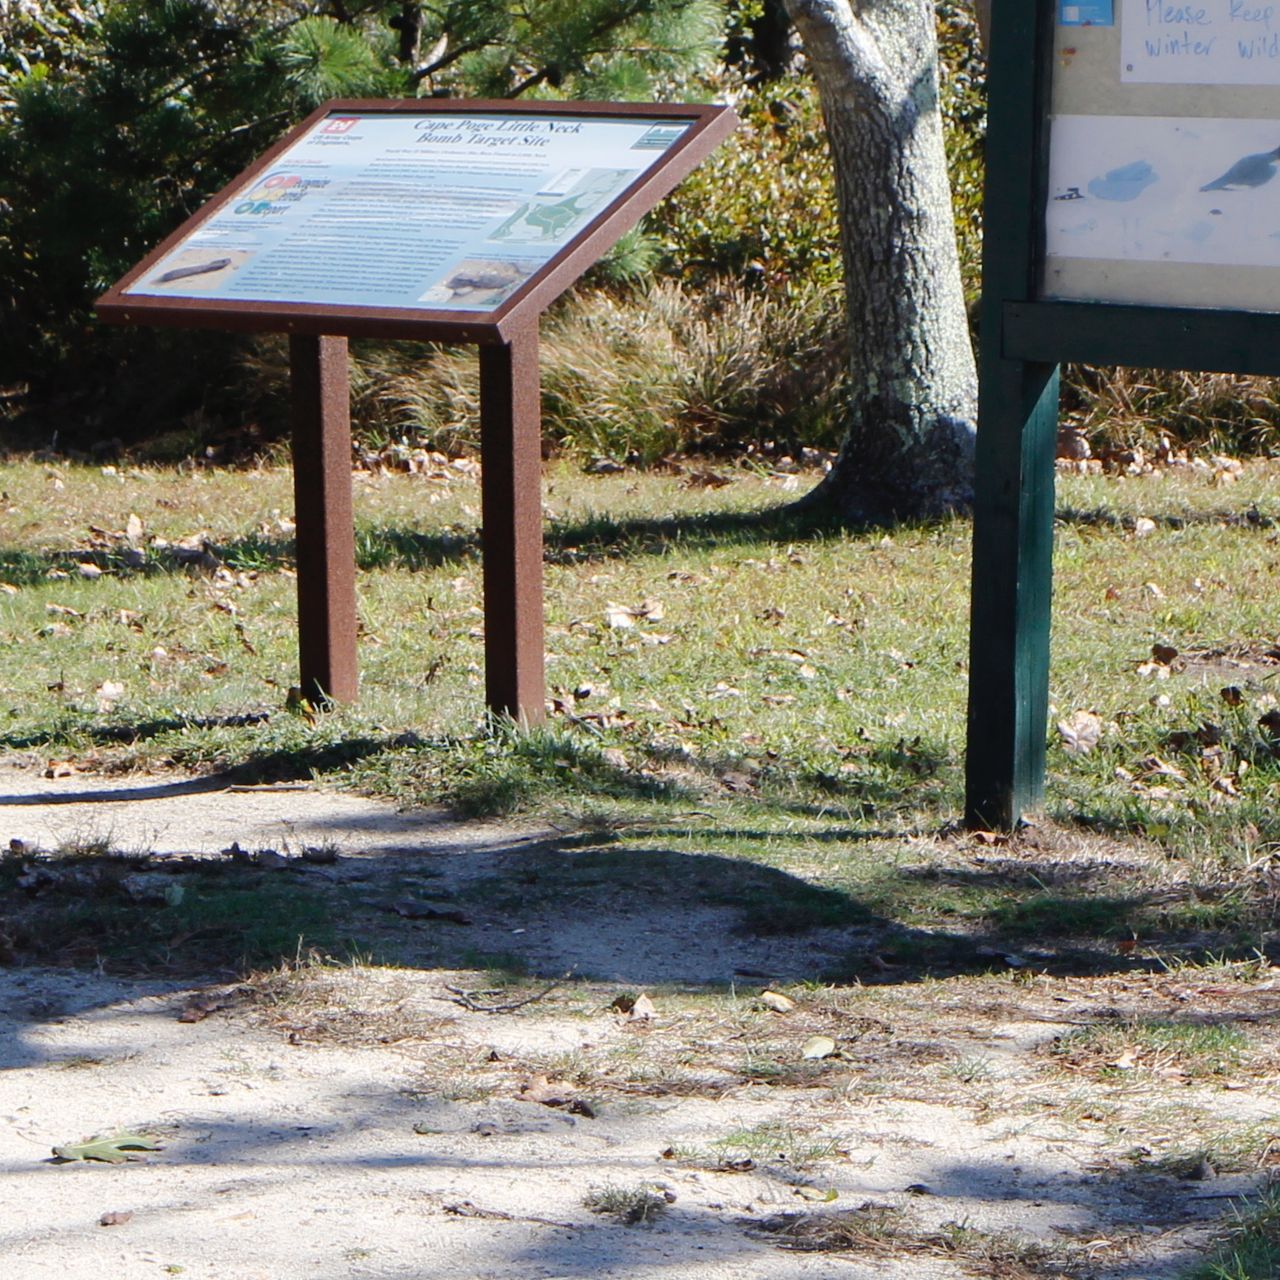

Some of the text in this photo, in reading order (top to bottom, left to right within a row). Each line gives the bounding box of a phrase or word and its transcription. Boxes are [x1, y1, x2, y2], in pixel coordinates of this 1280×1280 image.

[414, 119, 454, 132] Cape
[495, 120, 540, 133] Little
[541, 122, 583, 134] Neck
[416, 132, 551, 148] Bomb Target Site
